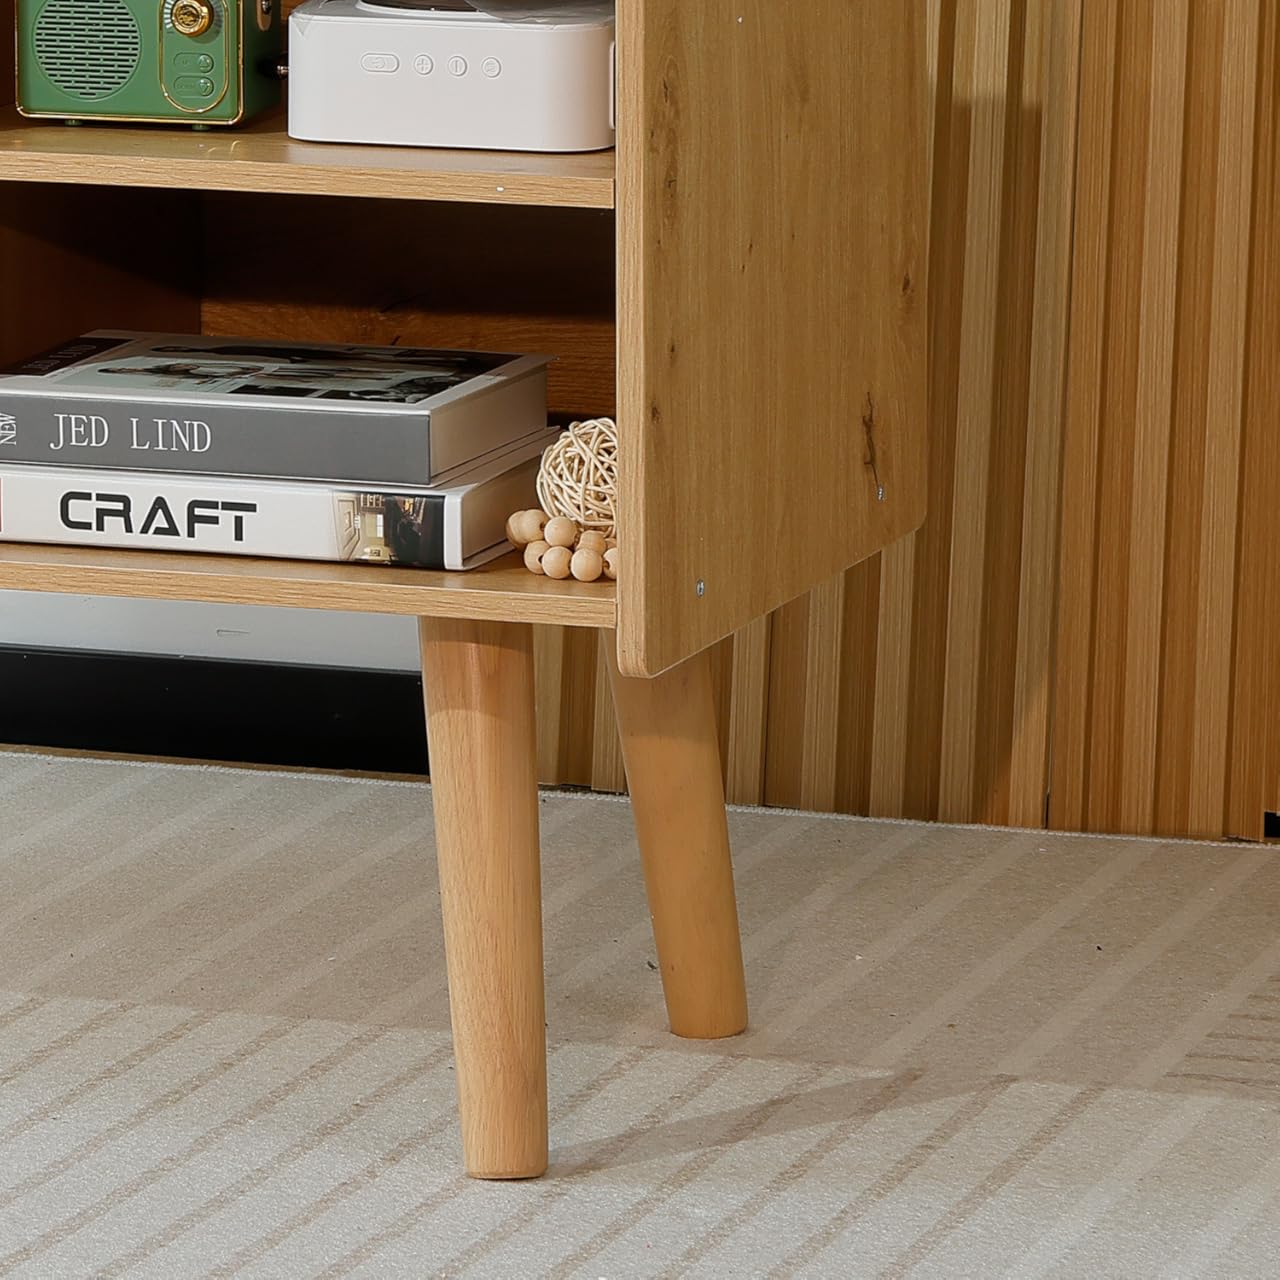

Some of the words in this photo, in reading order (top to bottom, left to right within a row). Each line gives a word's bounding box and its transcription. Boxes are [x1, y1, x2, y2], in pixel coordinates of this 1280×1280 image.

[0, 413, 17, 445] NEW
[50, 413, 109, 450] JED
[130, 418, 212, 452] LIND
[60, 491, 257, 541] CRAFT
